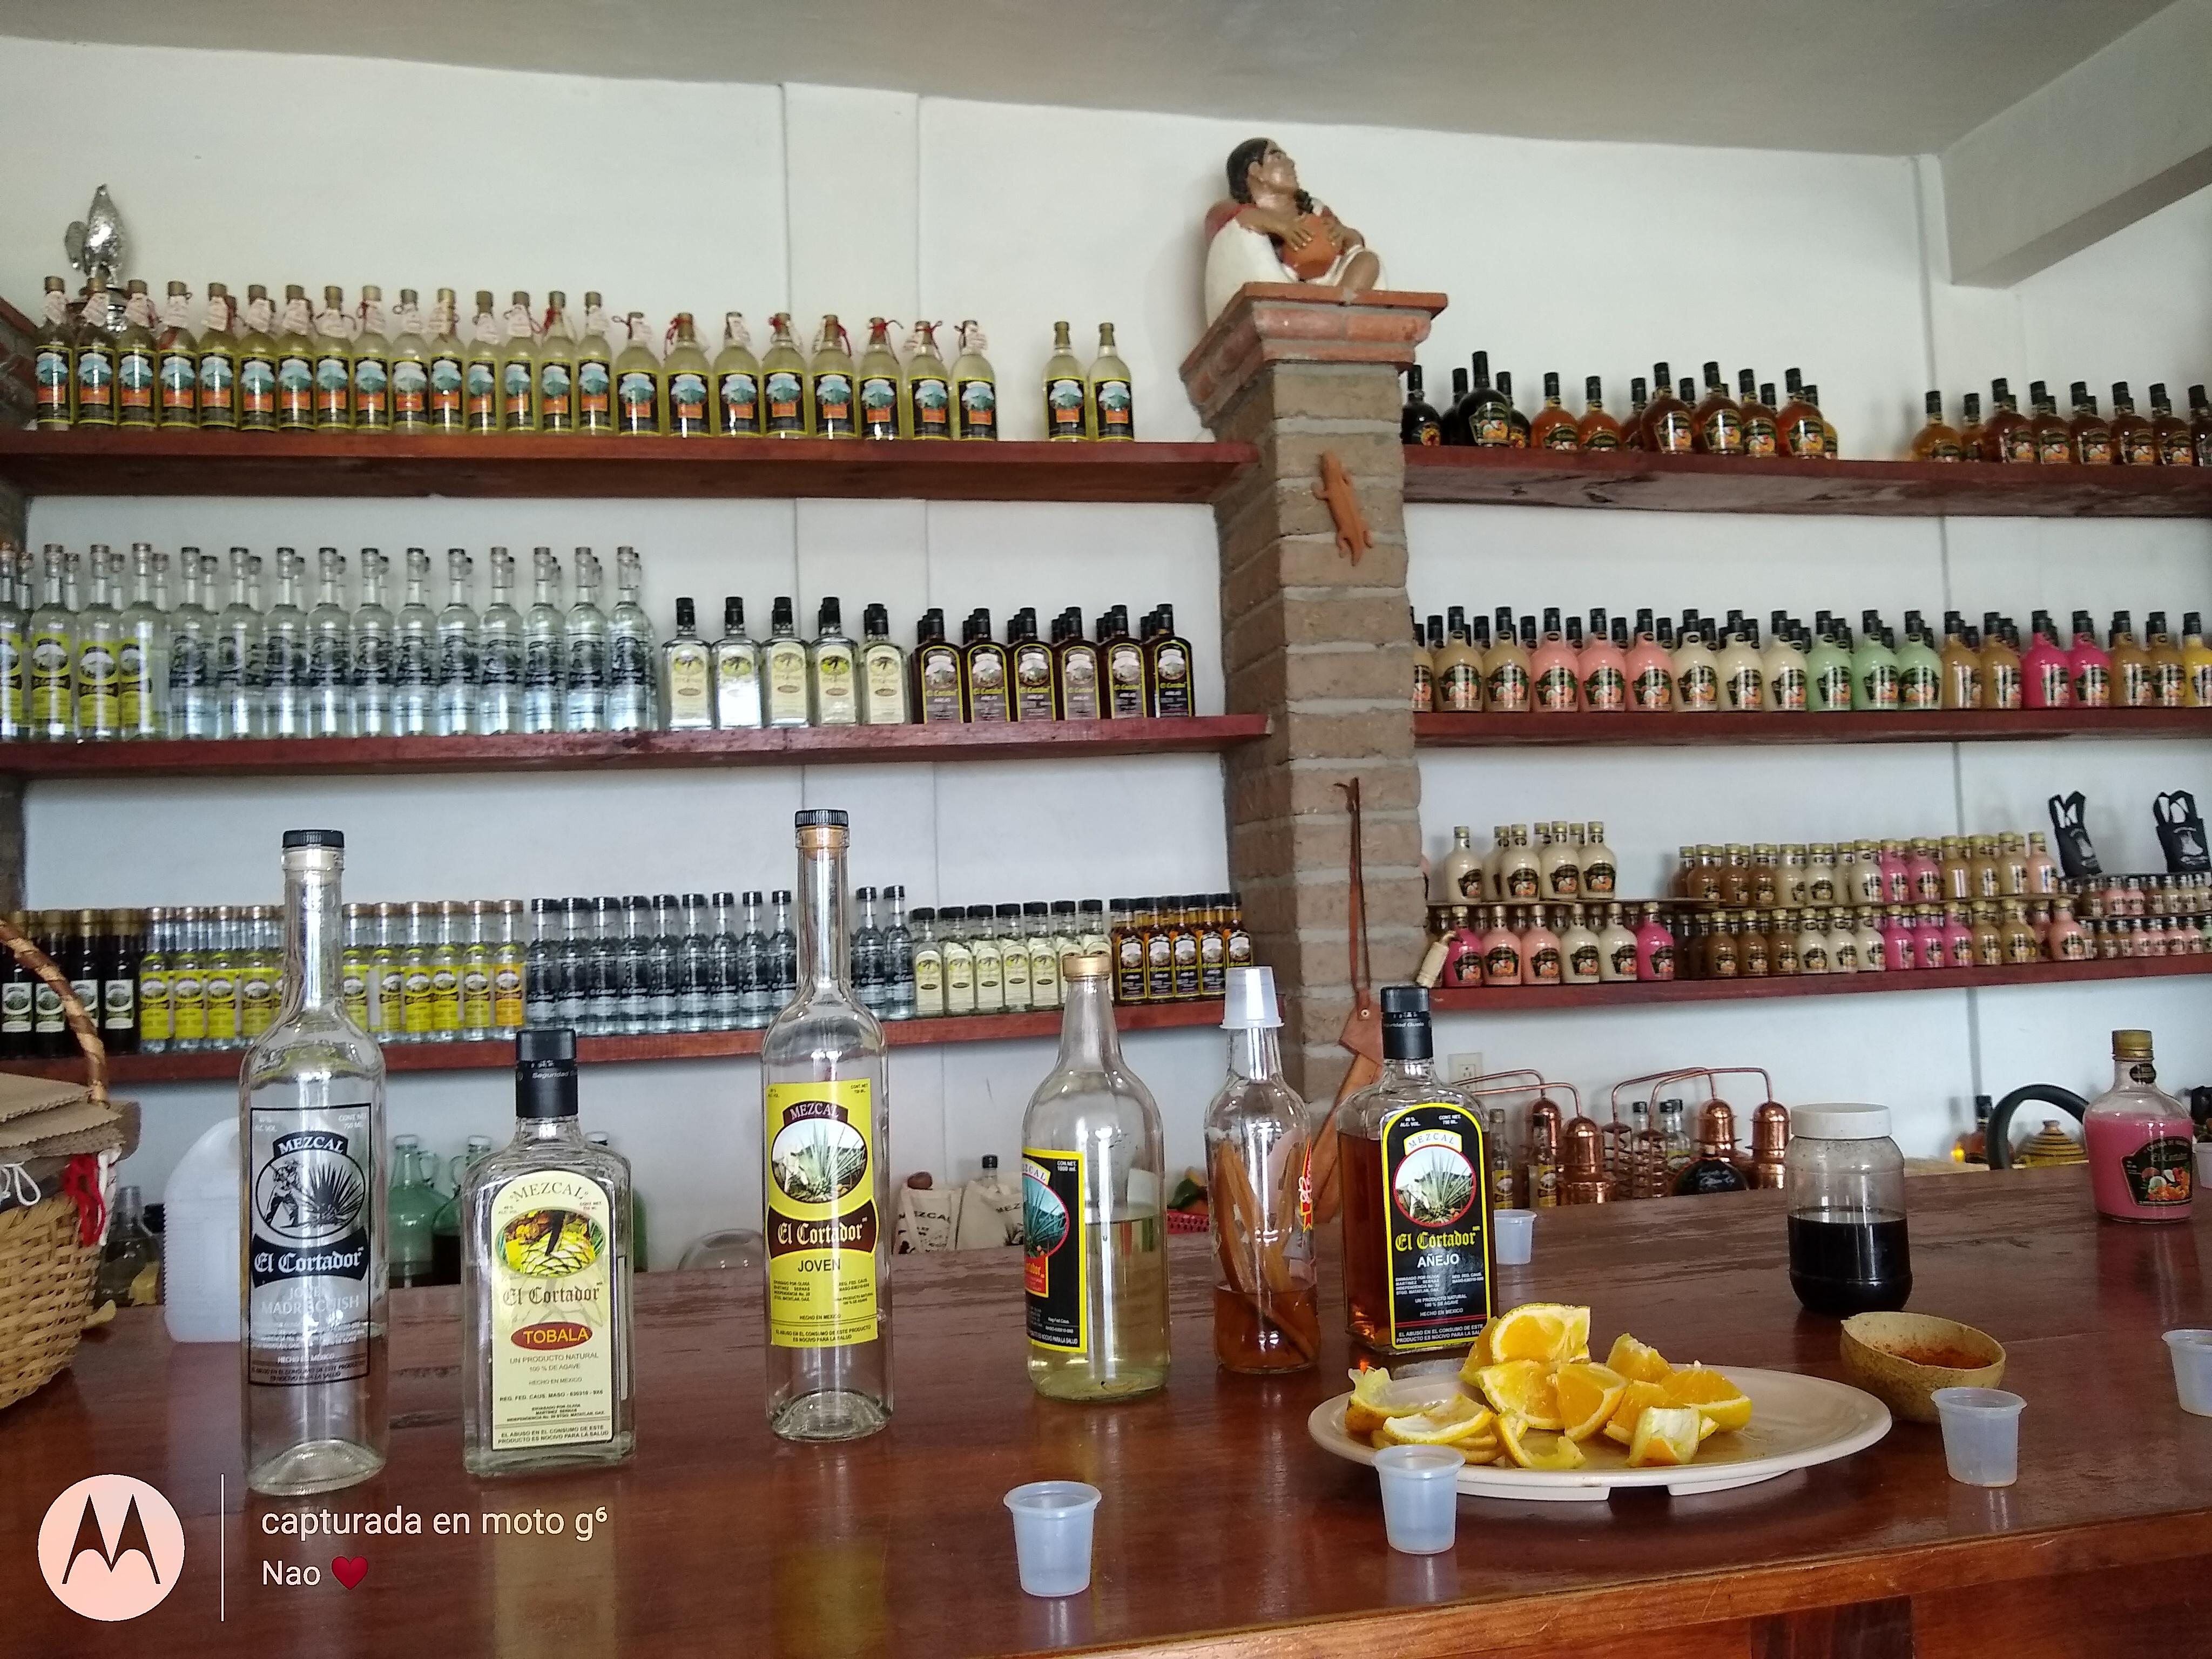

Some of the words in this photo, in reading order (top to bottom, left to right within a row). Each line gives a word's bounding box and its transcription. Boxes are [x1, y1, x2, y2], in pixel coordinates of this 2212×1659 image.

[531, 1071, 569, 1080] Seguridad
[789, 1102, 839, 1121] MEZCAL
[278, 1135, 346, 1155] MEZCAL
[1408, 1132, 1455, 1149] MEZCAL
[512, 1181, 584, 1203] MEZCAL
[777, 1221, 793, 1245] El
[796, 1221, 864, 1245] Cortador
[1395, 1231, 1413, 1252] El
[1416, 1230, 1476, 1250] Cortador
[254, 1251, 275, 1273] El
[278, 1250, 362, 1273] Cortador
[797, 1258, 841, 1272] JOVEN
[1417, 1253, 1460, 1269] AÑEJO
[503, 1286, 522, 1306] El
[528, 1285, 600, 1304] Cortador
[523, 1326, 590, 1345] TOBALA
[522, 1354, 564, 1364] PRODUCTO
[565, 1352, 599, 1361] NATURAL
[497, 1437, 531, 1445] PRODUCTO
